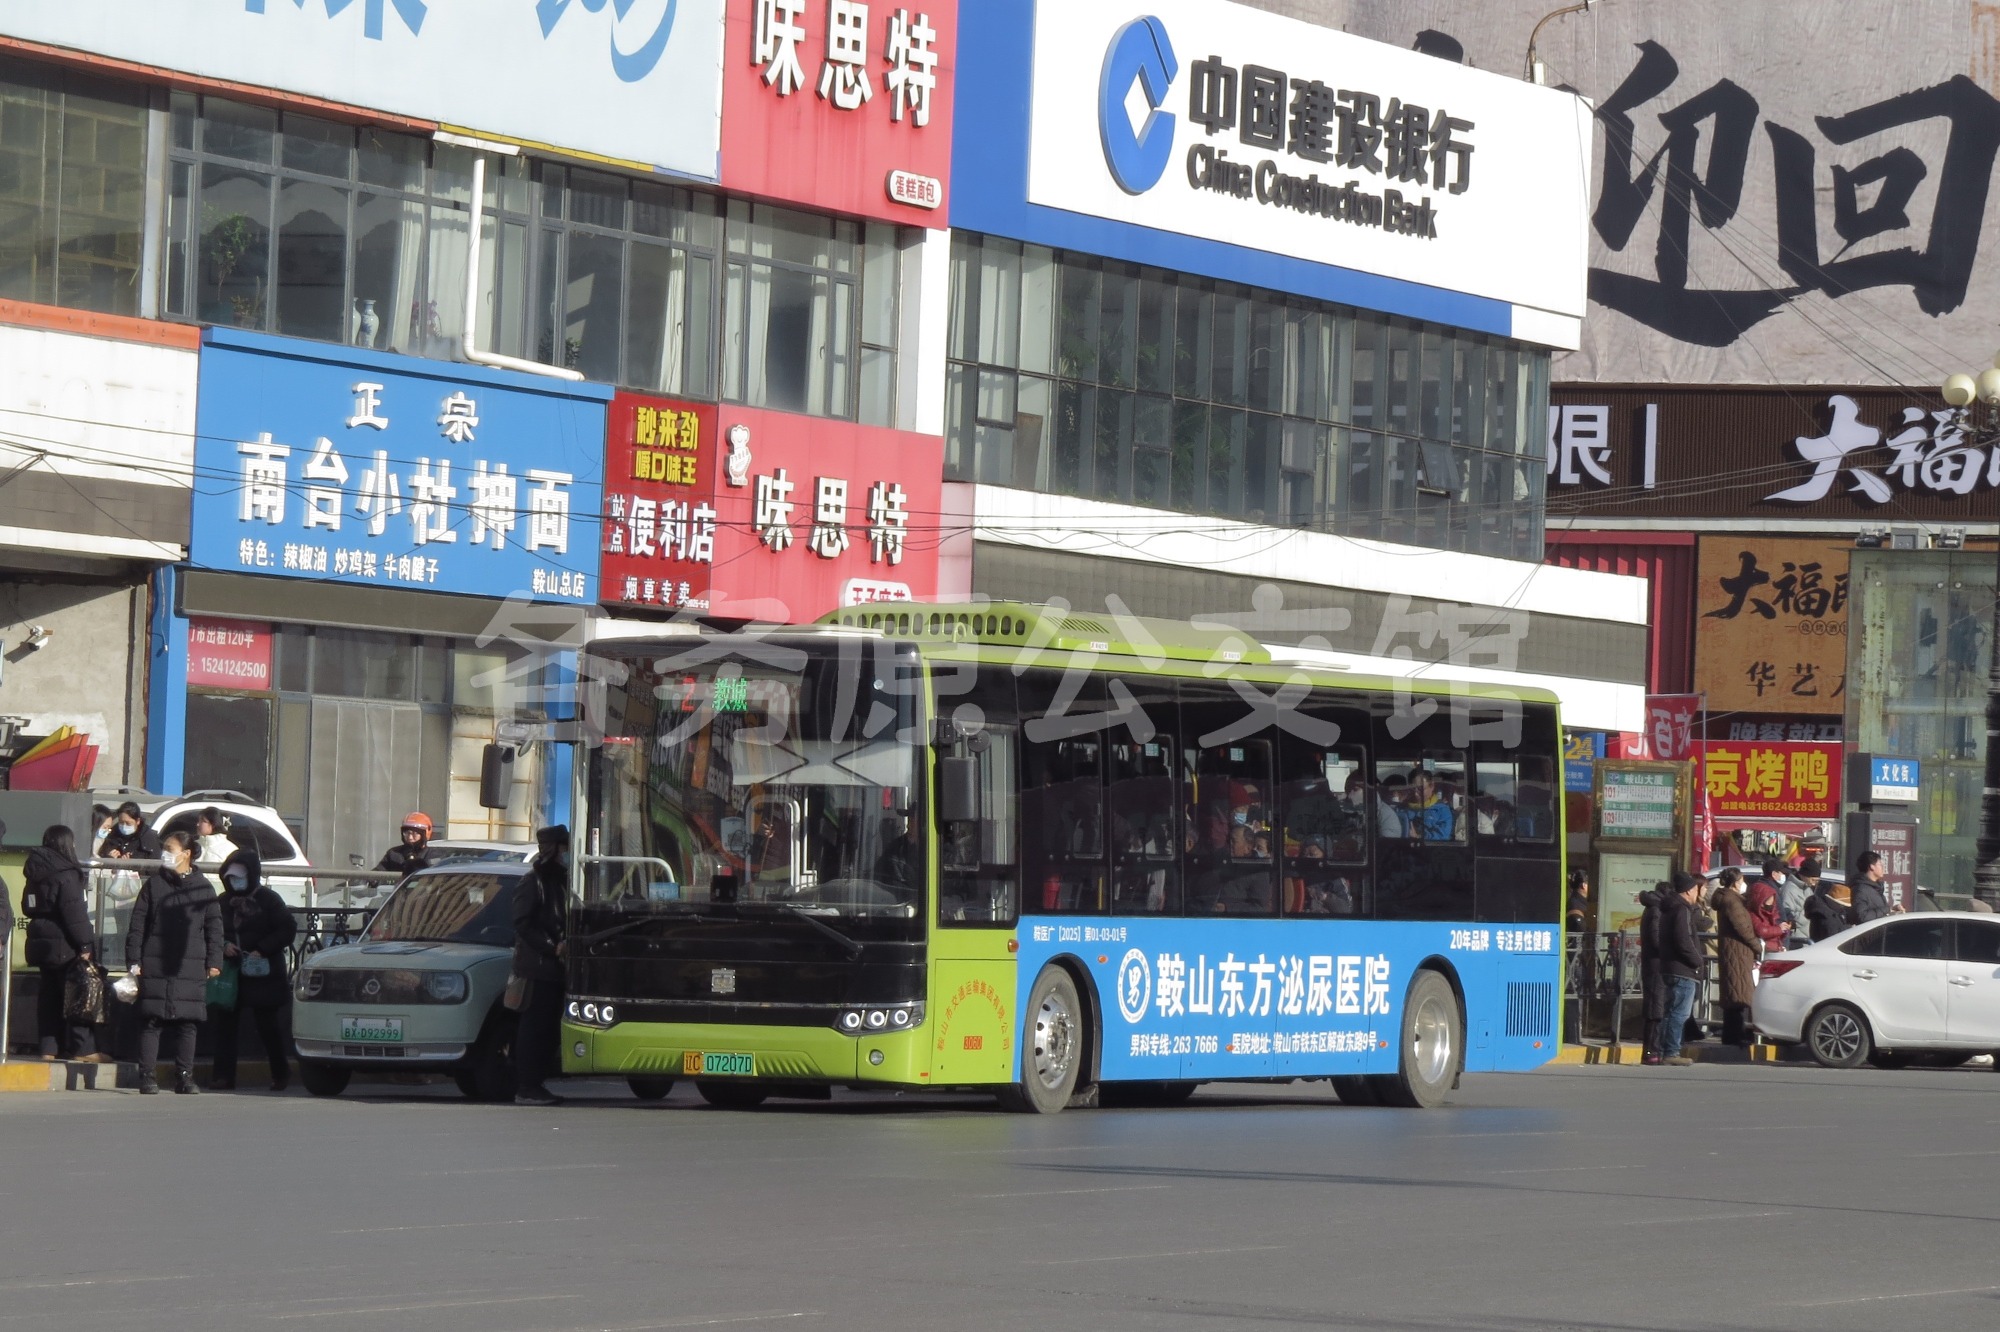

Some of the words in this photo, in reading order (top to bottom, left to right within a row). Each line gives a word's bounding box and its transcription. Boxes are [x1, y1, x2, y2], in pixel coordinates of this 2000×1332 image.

[750, 0, 938, 127] 味思特
[1189, 55, 1475, 195] 中国建设银行
[895, 175, 935, 203] 蛋糕面包
[1187, 143, 1253, 200] China
[1255, 159, 1382, 228] Construction
[1383, 188, 1437, 240] Bank
[636, 406, 699, 451] 秒来劲
[635, 450, 697, 485] 嚼口味王
[1763, 394, 2000, 504] 大福
[237, 432, 574, 555] 南台小杜抻面
[628, 495, 717, 563] 便利店
[753, 468, 909, 566] 味思特
[284, 542, 327, 574] 辣椒油
[334, 548, 377, 579] 炒鸡架
[384, 553, 439, 585] 牛肉腱子
[532, 568, 585, 599] 鞍山总店
[625, 575, 691, 605] 烟草专卖
[201, 656, 267, 679] 15241242500
[681, 676, 694, 711] 2
[1604, 786, 1616, 798] 101
[1624, 773, 1664, 786] 鞍山大厦
[1690, 748, 1830, 800] 京烤鸭
[1881, 762, 1909, 783] 文化街
[1450, 929, 1489, 951] 20年品牌
[1496, 929, 1551, 951] 专注男性健康
[1155, 951, 1390, 1018] 鞍山东方泌尿医院
[1173, 1036, 1191, 1054] 263
[1195, 1035, 1218, 1053] 7666
